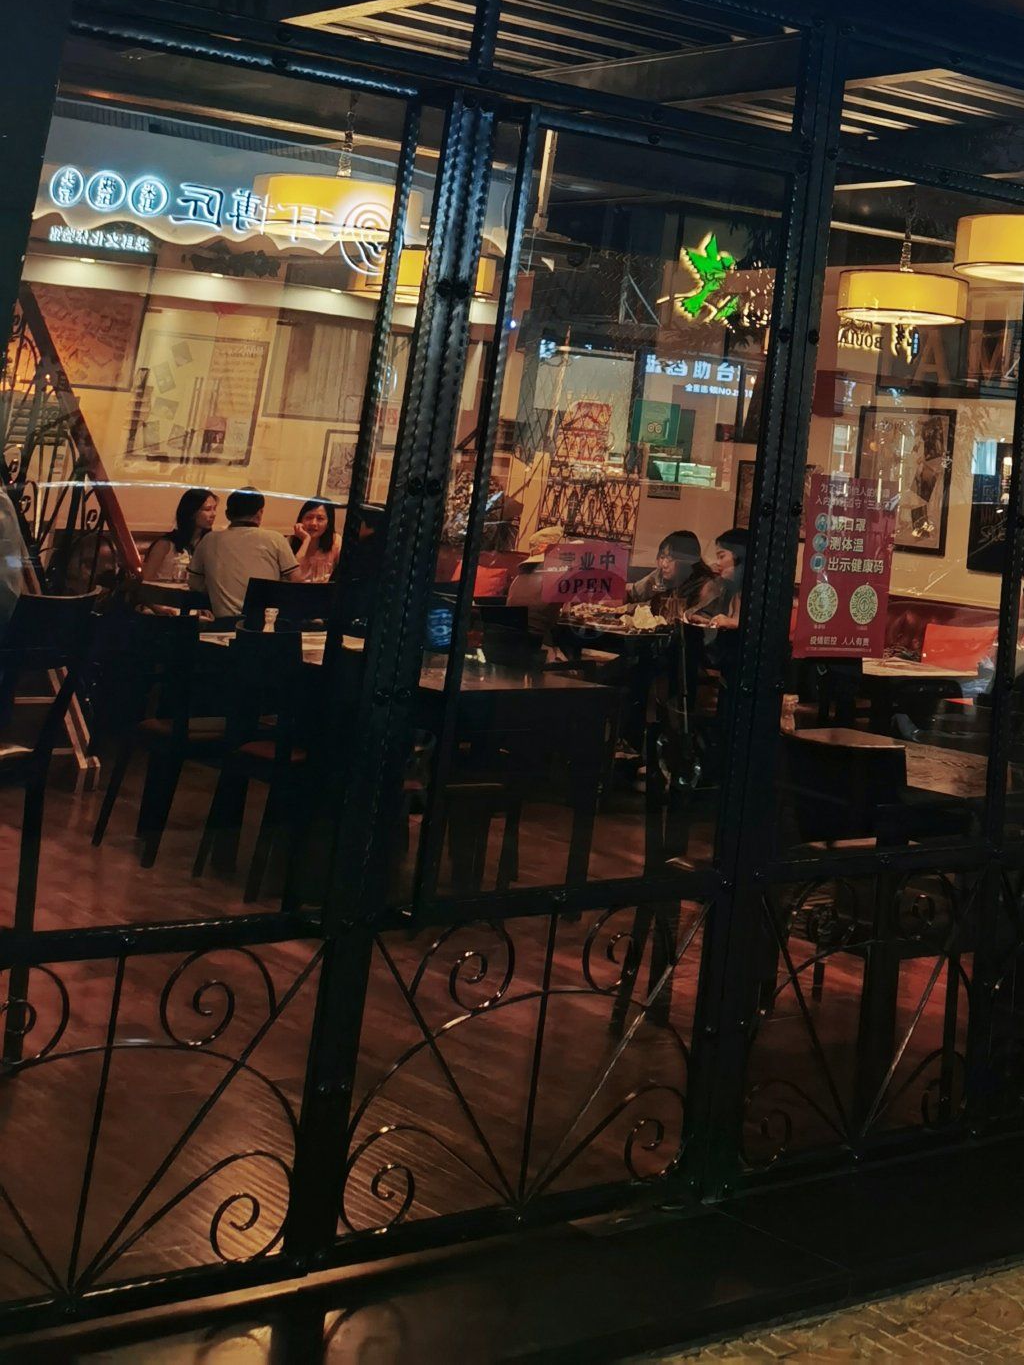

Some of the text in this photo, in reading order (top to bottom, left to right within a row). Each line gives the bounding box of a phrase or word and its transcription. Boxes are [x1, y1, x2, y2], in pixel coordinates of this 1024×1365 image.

[829, 536, 864, 552] 测体温
[827, 556, 884, 574] 出示健康码
[558, 577, 613, 594] OPEN
